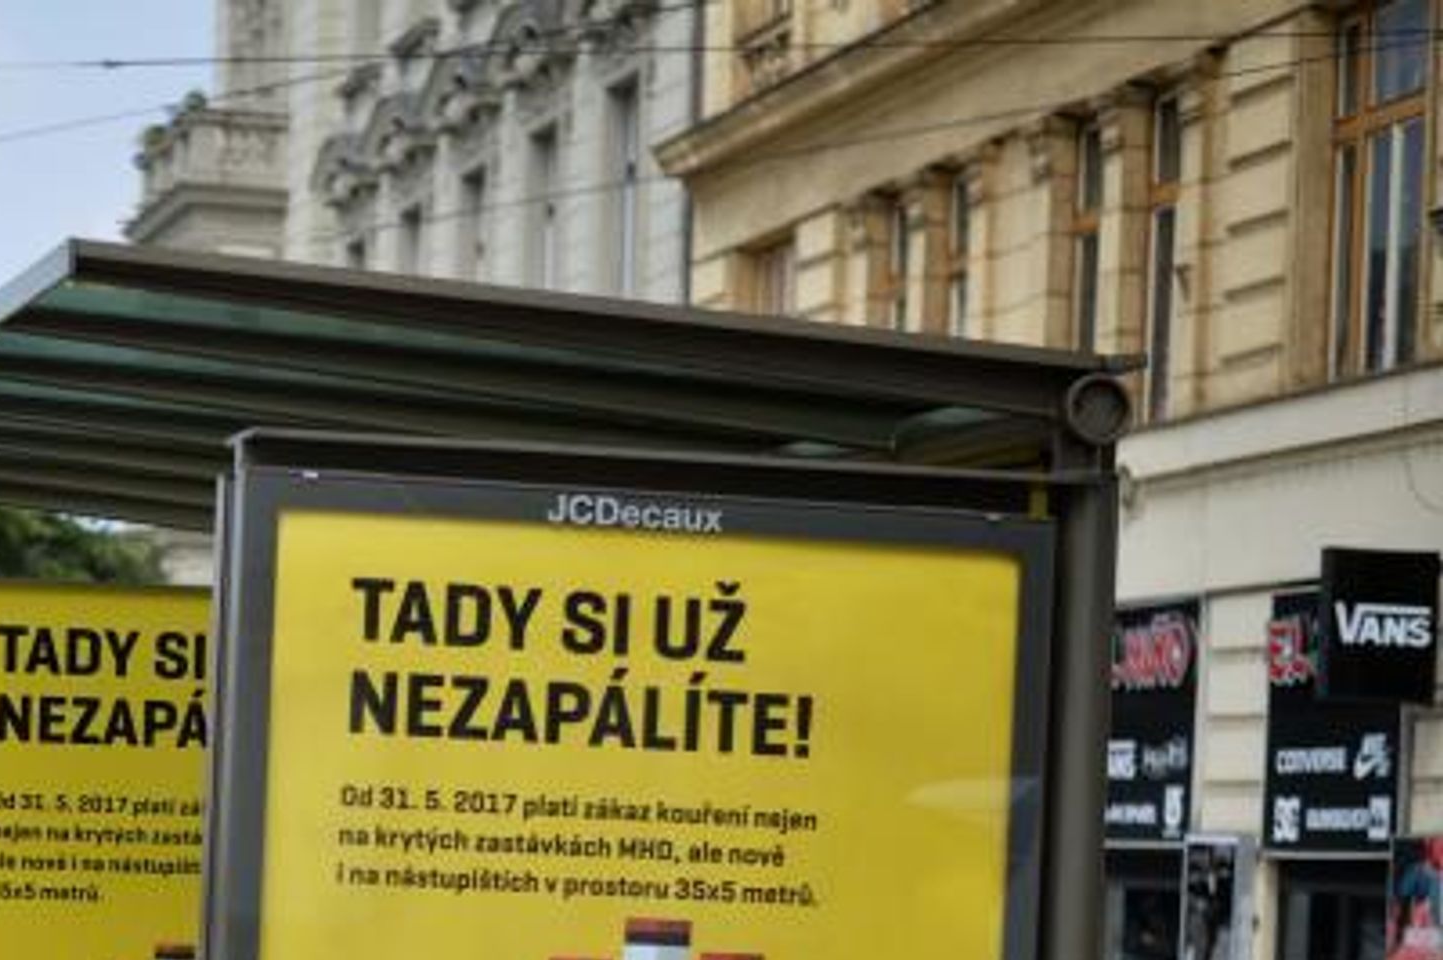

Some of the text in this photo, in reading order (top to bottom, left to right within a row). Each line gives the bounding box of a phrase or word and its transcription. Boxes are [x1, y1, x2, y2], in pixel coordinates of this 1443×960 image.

[547, 494, 724, 533] JCDecaux
[351, 577, 746, 663] TADY SI UŽ
[1333, 600, 1433, 648] VANS
[155, 631, 207, 681] SI
[349, 667, 814, 759] NEZAPÁLÍTE!
[78, 793, 128, 814] 2017
[179, 797, 205, 818] zá
[341, 785, 818, 835] Od 31. 5. 2017 platí zákaz kouření nejen
[46, 826, 70, 842] na
[338, 825, 785, 868] na krytých zastávkách MHD, ale nově
[349, 869, 380, 885] na
[385, 864, 539, 895] nástupištích
[544, 876, 558, 893] v
[562, 876, 669, 901] prostoru
[674, 877, 737, 903] 35x5
